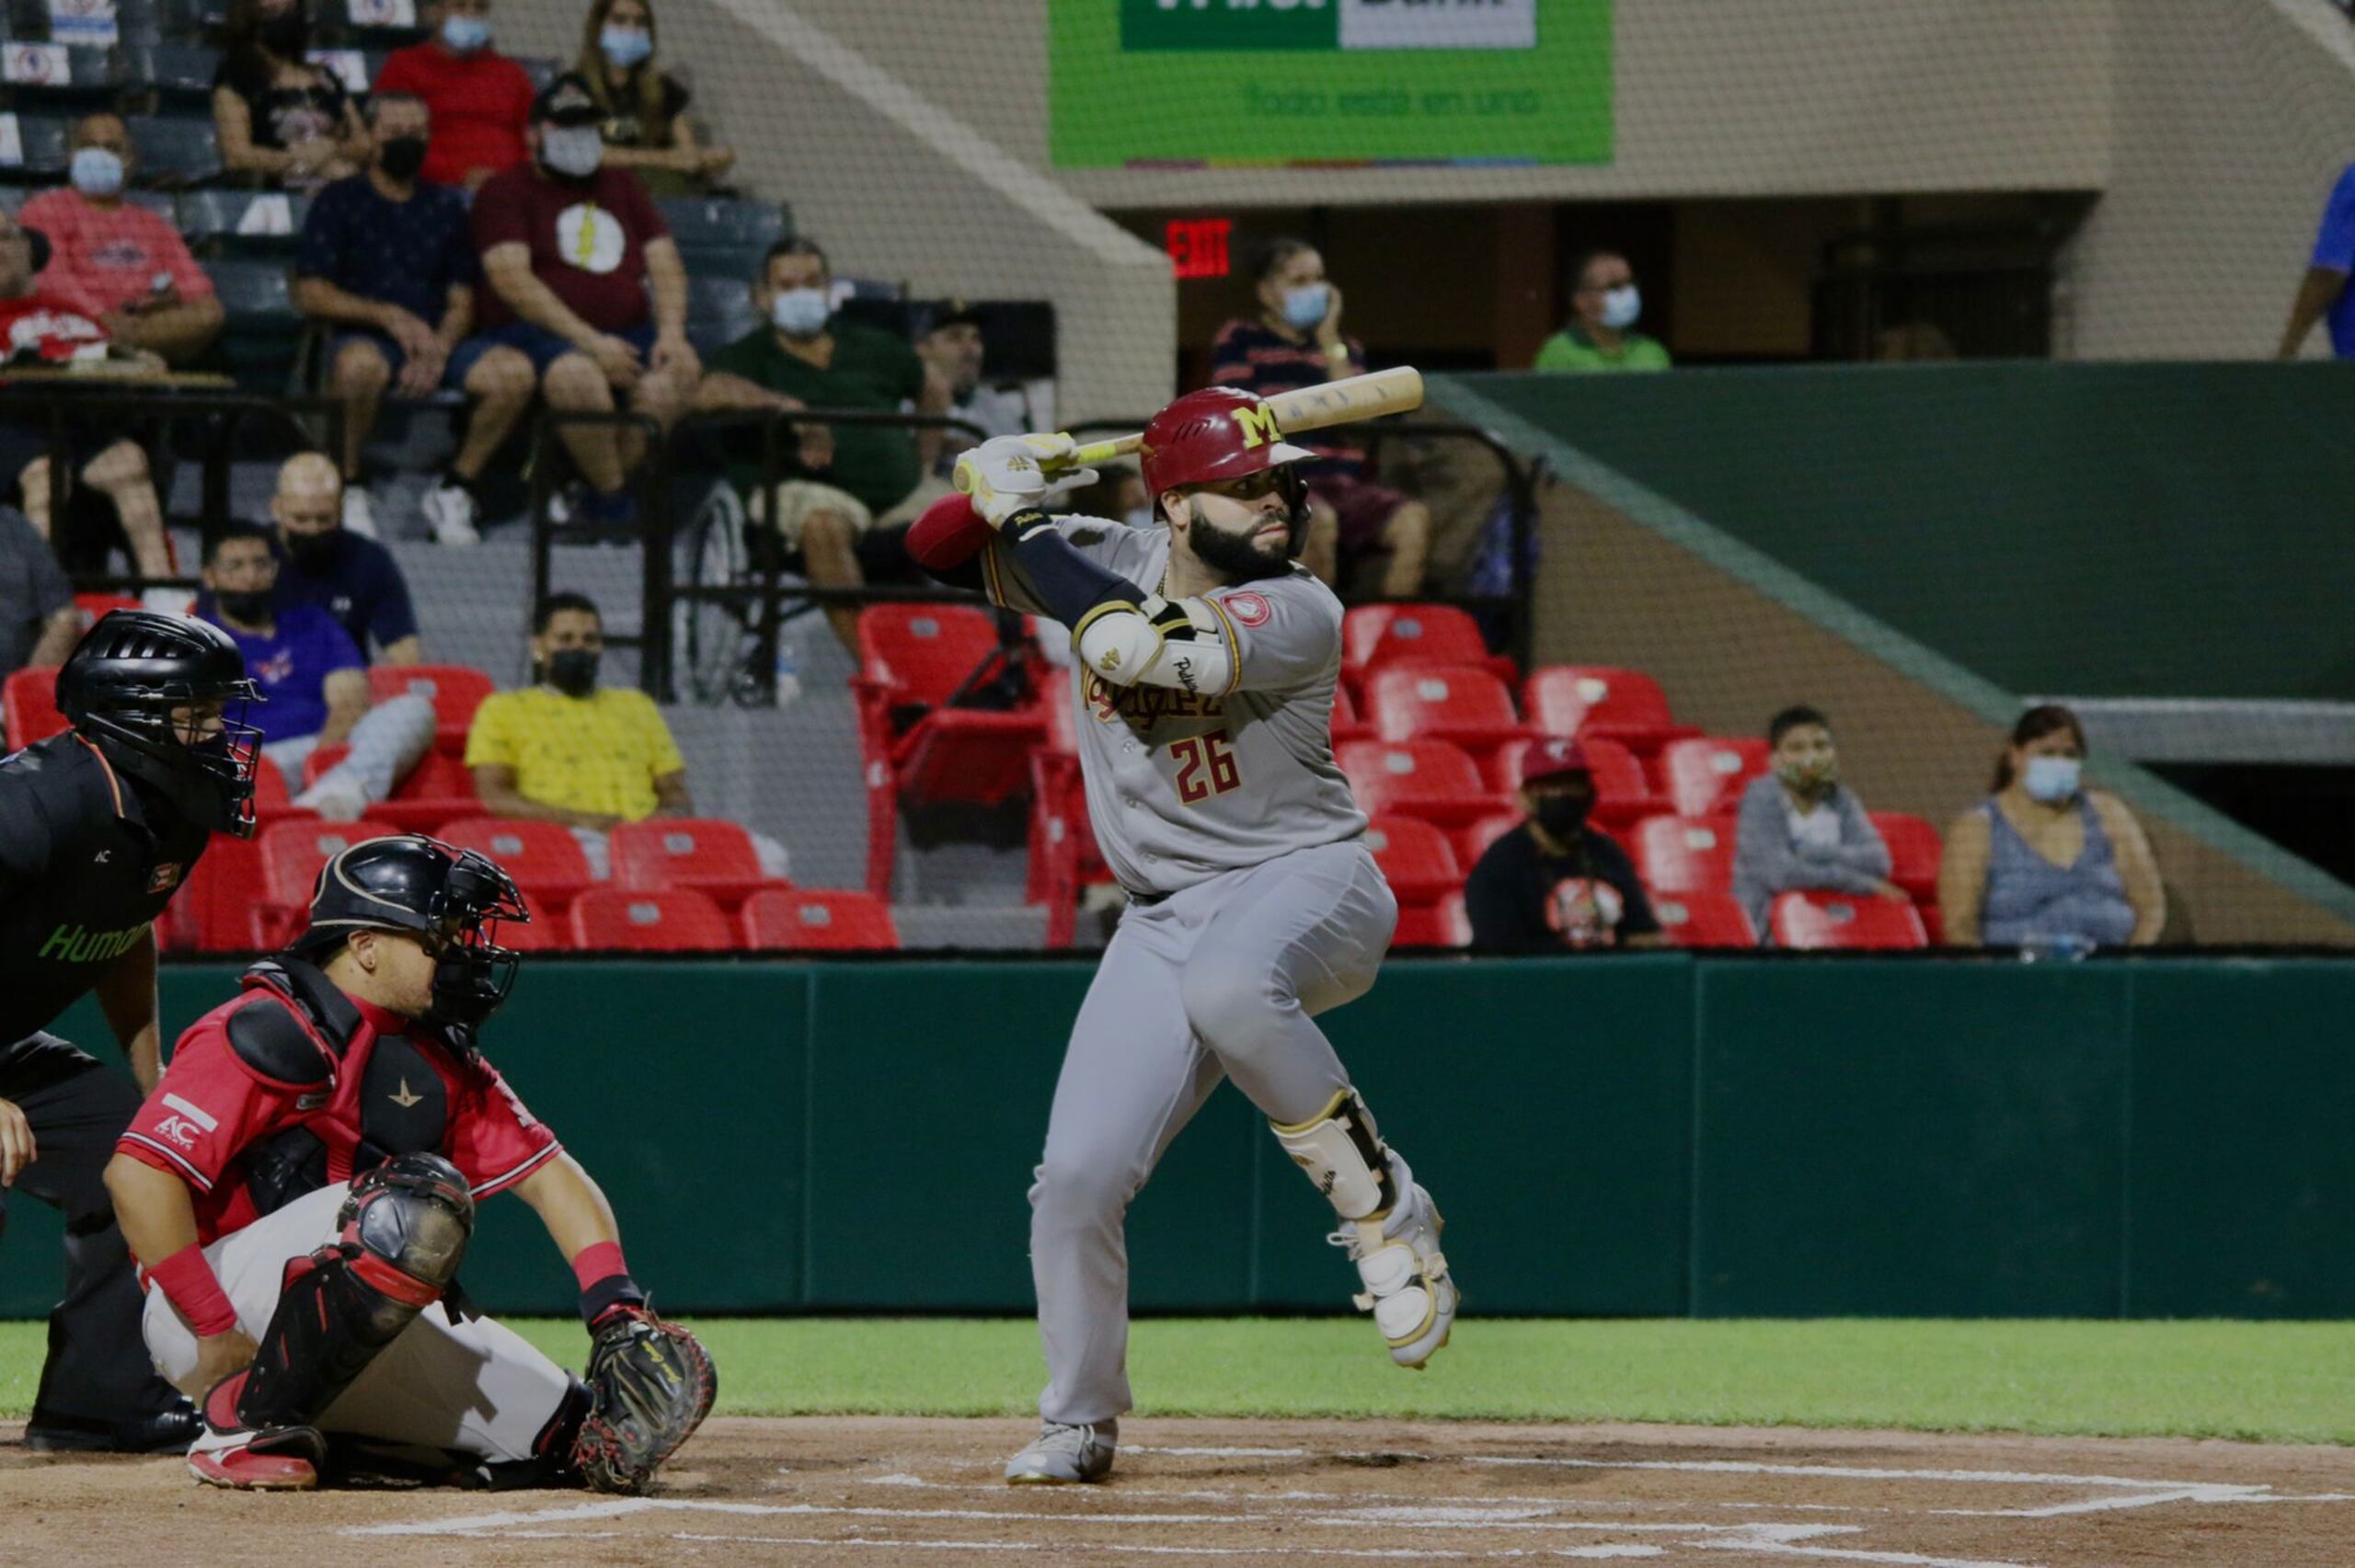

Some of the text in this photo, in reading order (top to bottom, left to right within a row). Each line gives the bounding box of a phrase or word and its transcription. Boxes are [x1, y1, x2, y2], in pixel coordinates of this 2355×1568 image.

[1166, 220, 1233, 279] EXIT
[1230, 401, 1284, 451] M
[1168, 728, 1242, 807] 26
[94, 849, 111, 864] AC
[157, 1116, 201, 1145] AC
